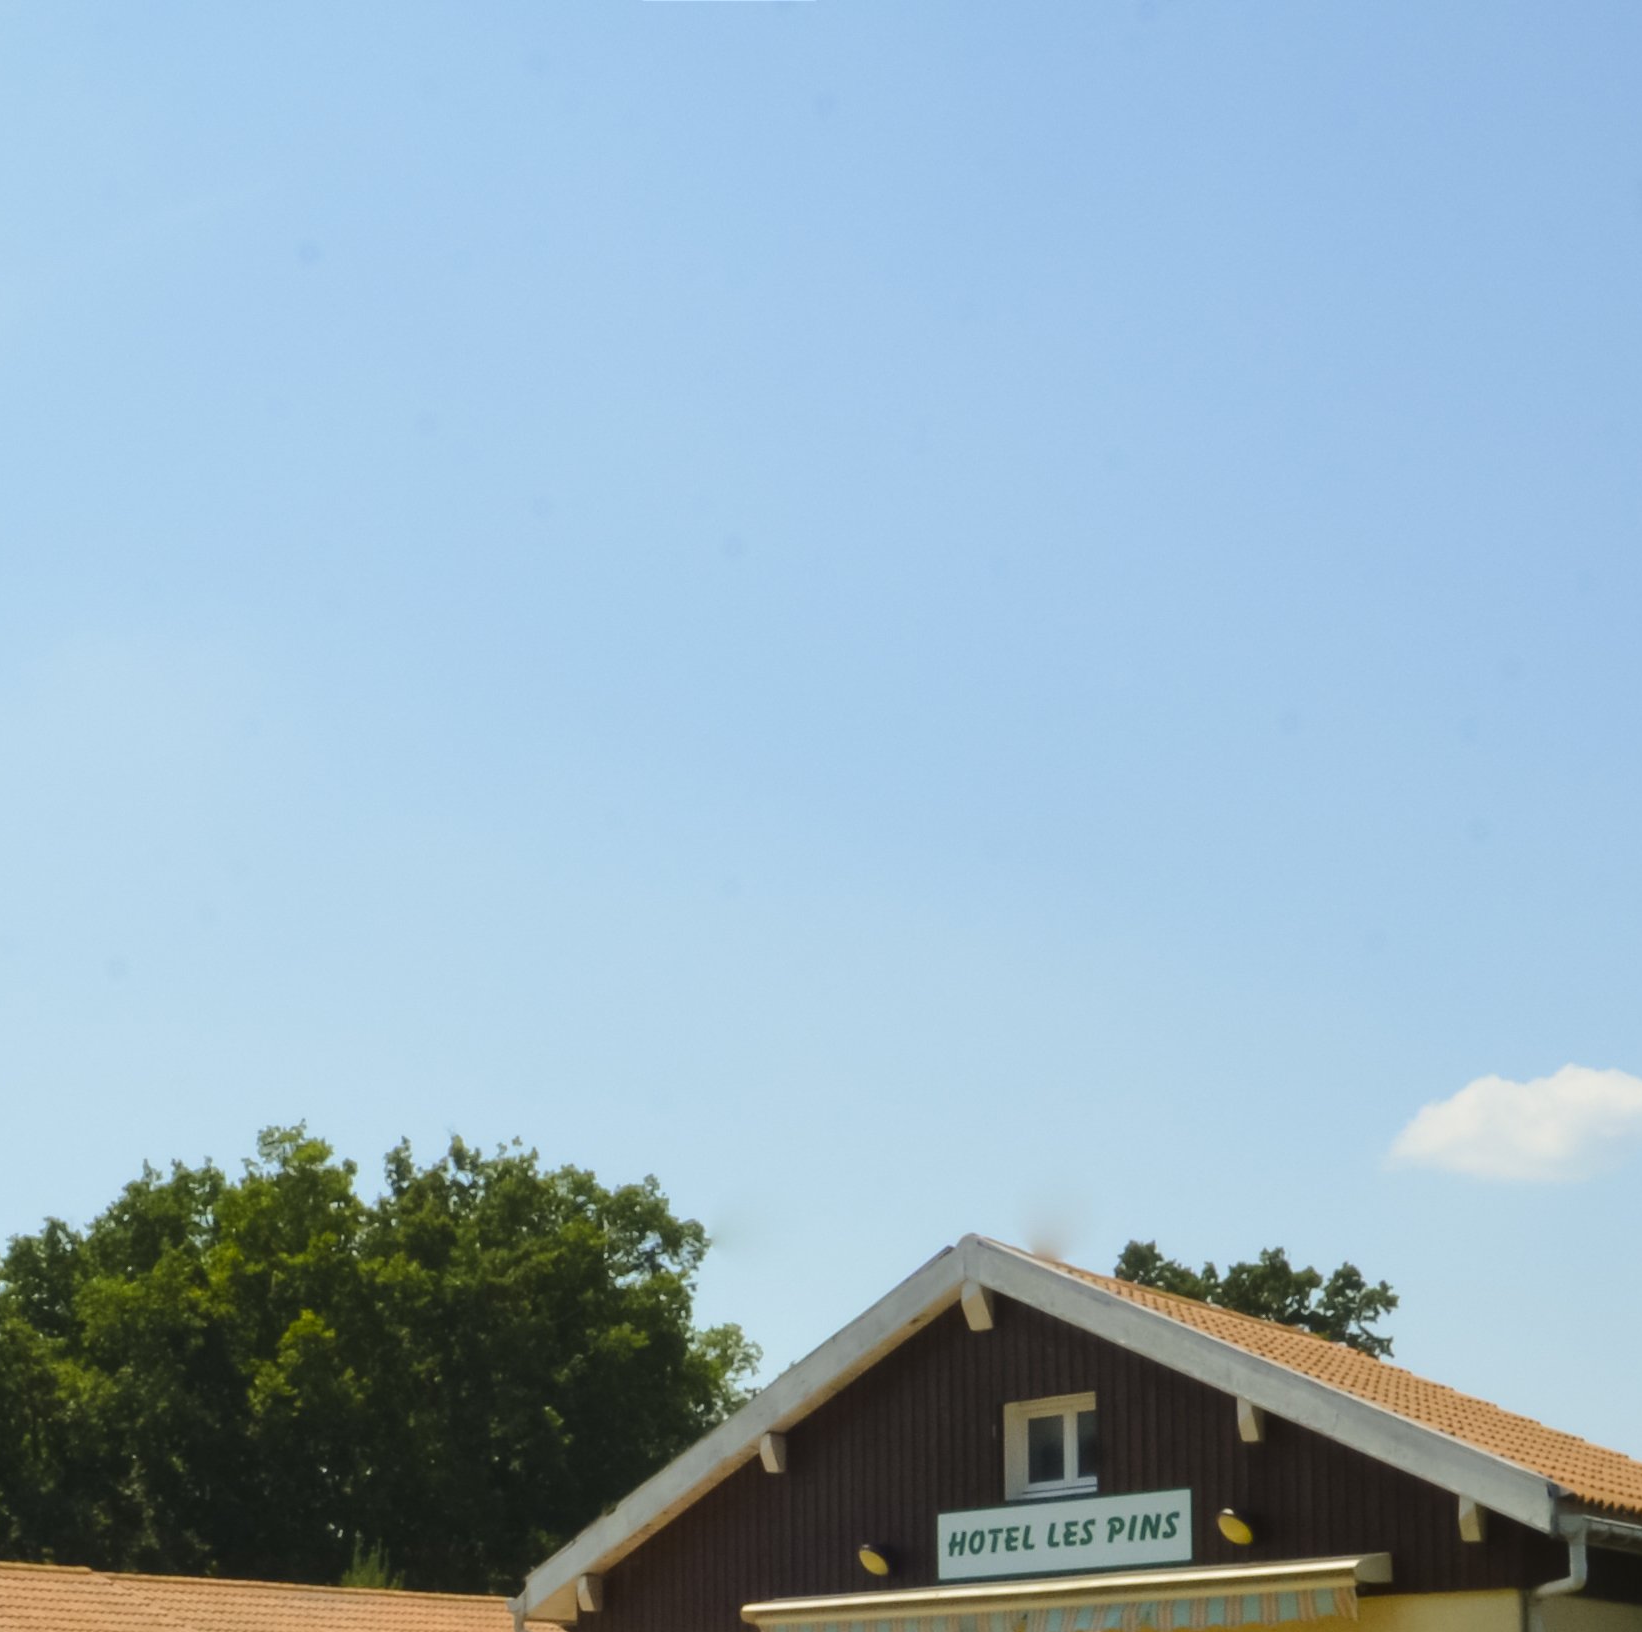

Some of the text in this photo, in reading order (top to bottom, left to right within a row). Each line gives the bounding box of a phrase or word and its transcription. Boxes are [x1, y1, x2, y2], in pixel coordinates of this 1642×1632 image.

[948, 1511, 1181, 1557] HOTEL LES PINS
